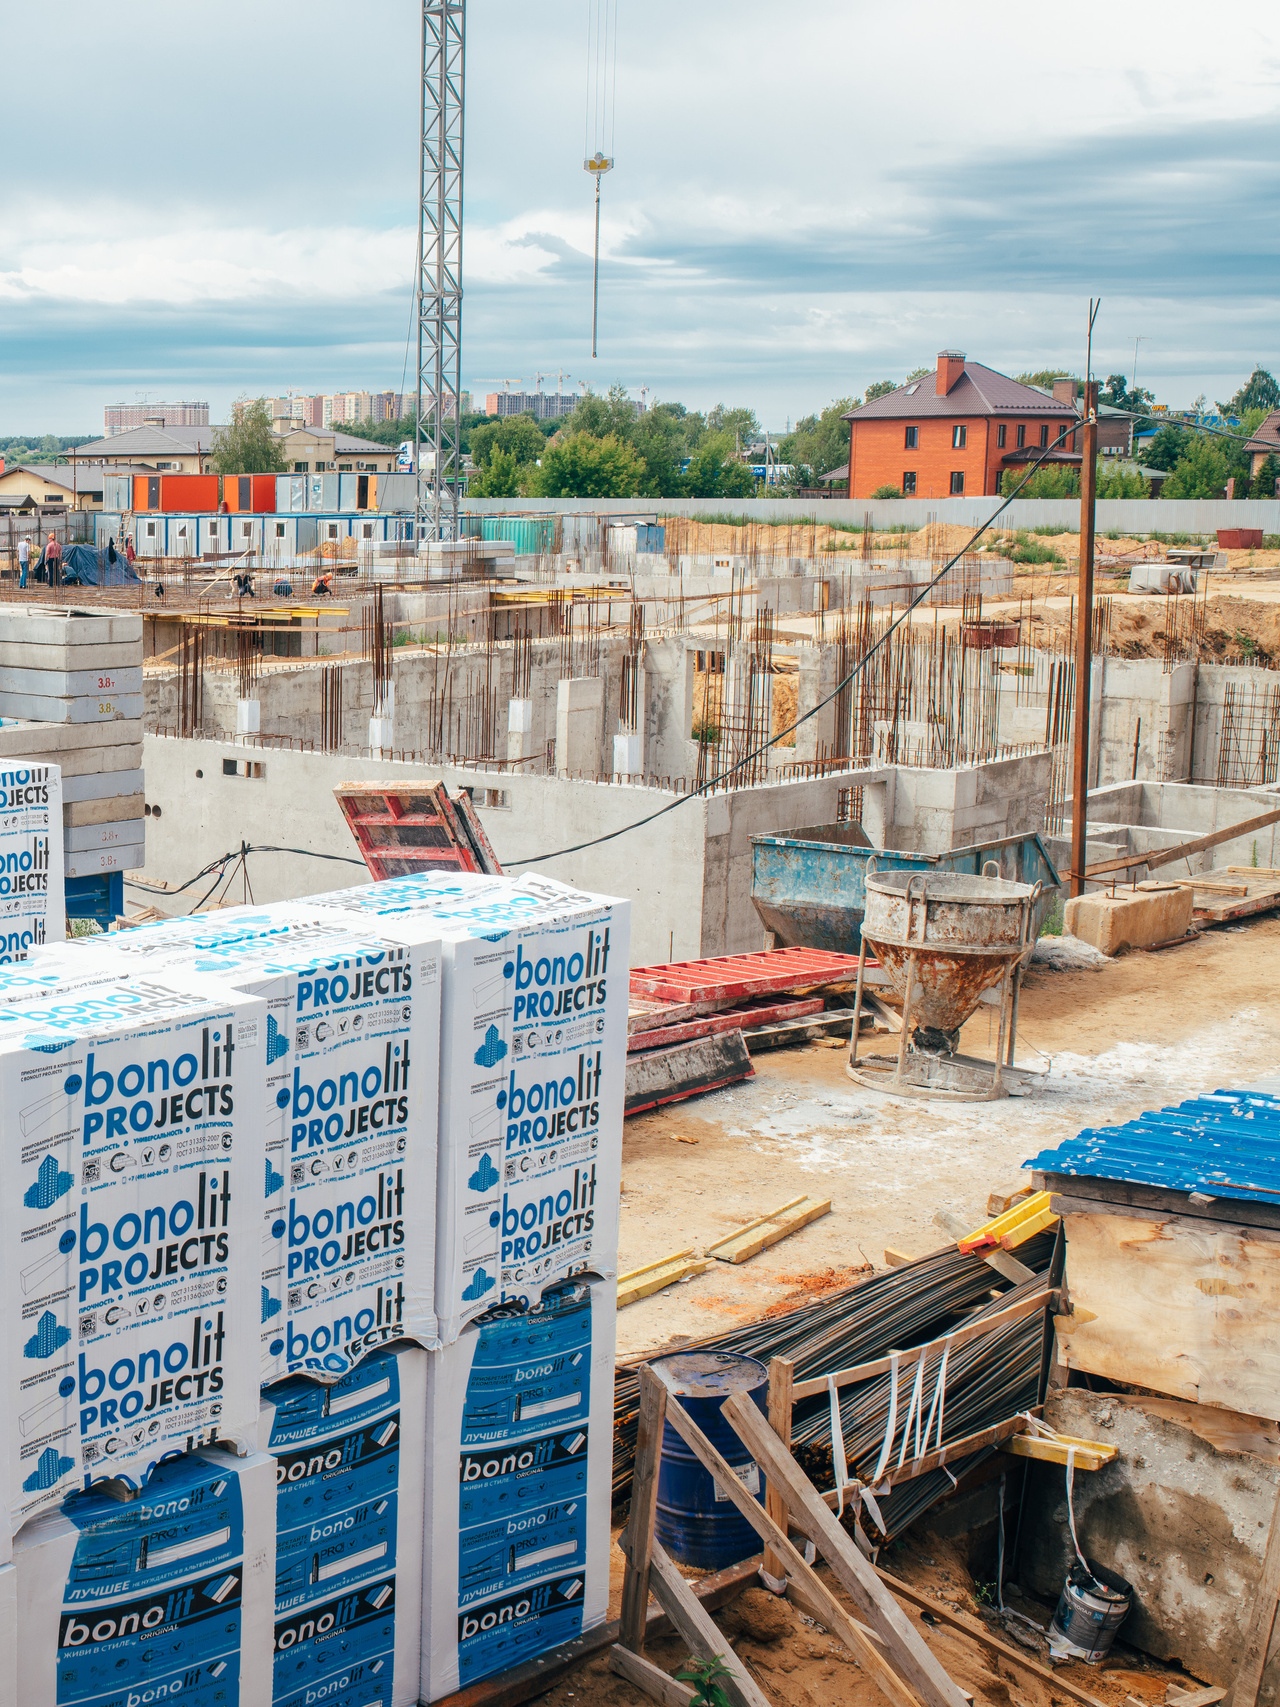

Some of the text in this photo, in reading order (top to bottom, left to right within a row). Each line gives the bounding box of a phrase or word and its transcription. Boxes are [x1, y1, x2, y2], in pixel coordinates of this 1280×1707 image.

[515, 927, 610, 990] bonolit
[1, 980, 180, 1022] bonolit
[297, 964, 412, 1011] PROJECTS
[513, 979, 606, 1022] PROJECTS
[45, 993, 208, 1030] PROJECTS
[84, 1023, 235, 1107] bonolit
[292, 1039, 410, 1119] bonolit
[507, 1051, 601, 1120] bonolit
[83, 1083, 233, 1146] PROJECTS
[291, 1096, 408, 1152] PROJECTS
[506, 1102, 599, 1150] PROJECTS
[82, 1121, 233, 1158] ПРОЧНОСТЬ УНИВЕРСАЛЬНОСТЬ ПРАКТИЧНОСТЬ
[79, 1170, 231, 1264] bonolit
[288, 1169, 405, 1248] bonolit
[501, 1163, 596, 1237] bonolit
[288, 1220, 404, 1279] PROJECTS
[501, 1210, 594, 1263] PROJECTS
[79, 1232, 229, 1303] PROJECTS
[287, 1281, 405, 1362] bonolit
[528, 1315, 554, 1325] ORIGINAL
[78, 1311, 225, 1405] bonolit
[288, 1324, 404, 1373] PROJECTS
[514, 1357, 565, 1382] bonolit
[80, 1367, 223, 1435] PROJECTS
[272, 1426, 318, 1445] ЛУЧШЕЕ
[464, 1429, 509, 1442] ЛУЧШЕЕ
[322, 1466, 353, 1481] ORIGINAL
[463, 1439, 556, 1482] bonolit
[516, 1467, 544, 1480] ORIGINAL
[140, 1486, 205, 1520] bonolit
[310, 1506, 369, 1542] bonolit
[507, 1506, 560, 1535] bonolit
[68, 1580, 131, 1600] ЛУЧШЕЕ
[461, 1581, 505, 1603] ЛУЧШЕЕ
[63, 1588, 195, 1648] bonolit
[139, 1624, 179, 1641] ORIGINAL
[461, 1585, 552, 1640] bonolit
[63, 1647, 92, 1659] ЖИВИ
[315, 1627, 347, 1645] ORIGINAL
[126, 1668, 201, 1707] bonolit
[305, 1665, 364, 1704] bonolit
